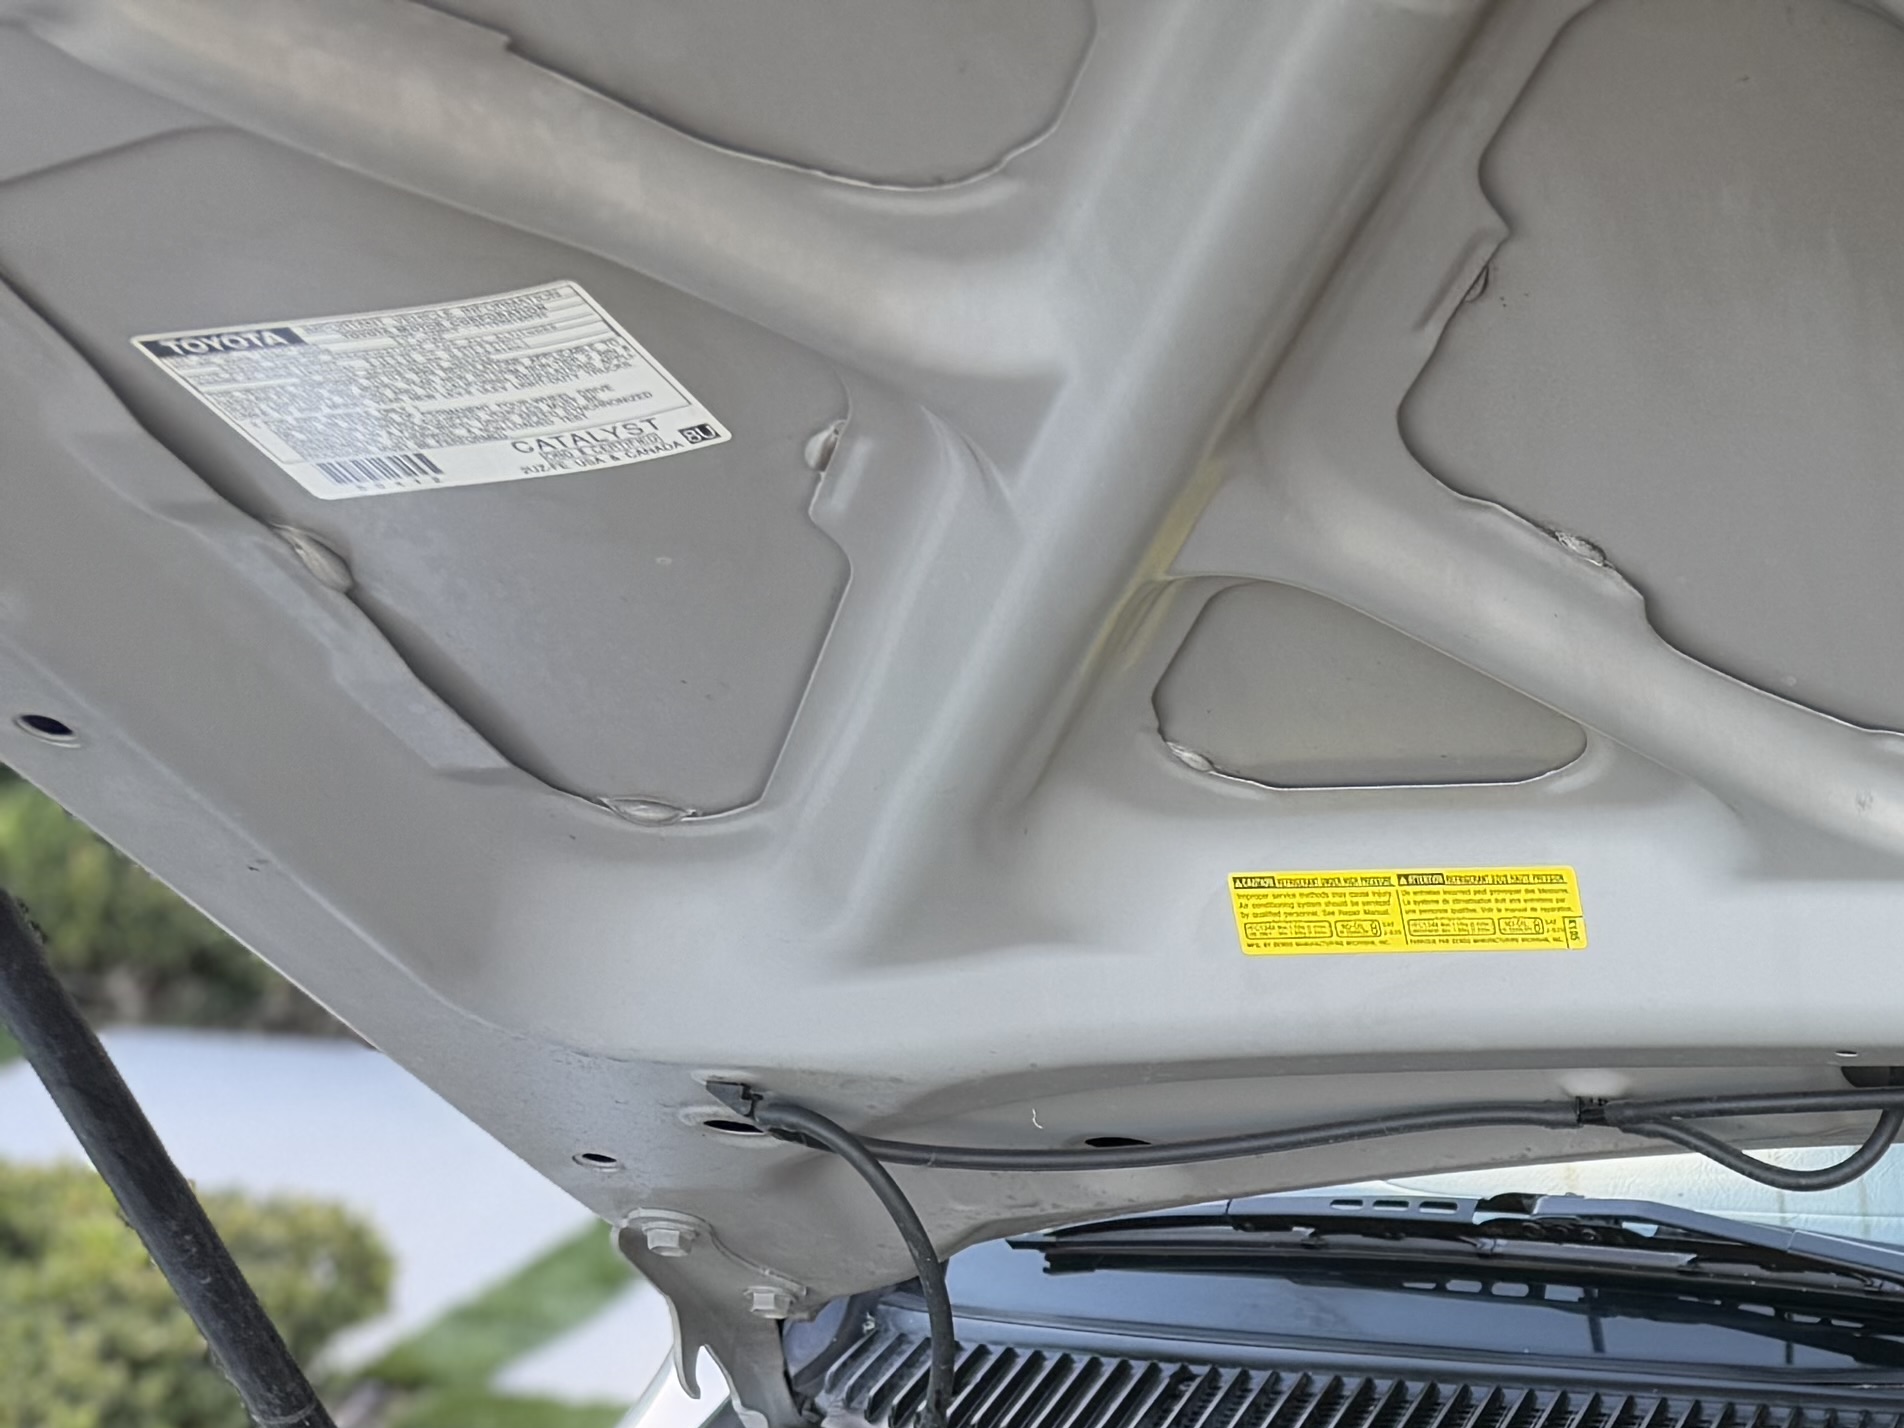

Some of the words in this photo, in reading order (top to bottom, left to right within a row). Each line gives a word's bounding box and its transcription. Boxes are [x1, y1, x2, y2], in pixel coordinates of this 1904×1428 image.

[159, 329, 288, 356] TOYOTA
[509, 416, 662, 455] CATALYST
[684, 424, 718, 444] 8U
